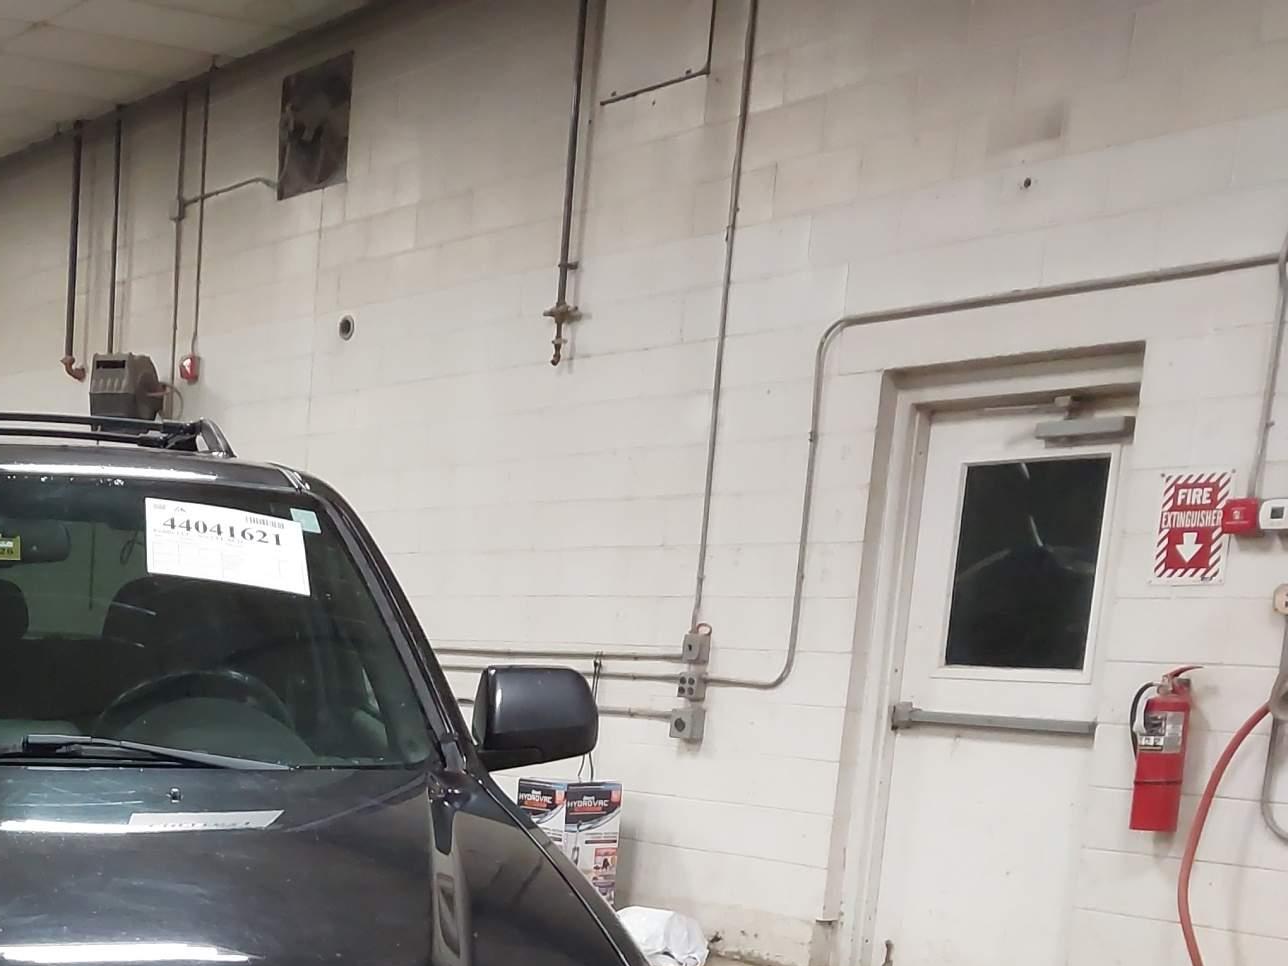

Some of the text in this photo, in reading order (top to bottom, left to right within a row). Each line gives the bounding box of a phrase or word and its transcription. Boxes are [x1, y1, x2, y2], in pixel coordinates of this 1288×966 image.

[1177, 487, 1213, 506] FIRE
[1160, 509, 1224, 530] EXTINGUISHER
[162, 516, 282, 546] 44041621
[567, 800, 609, 808] HYDROVAC
